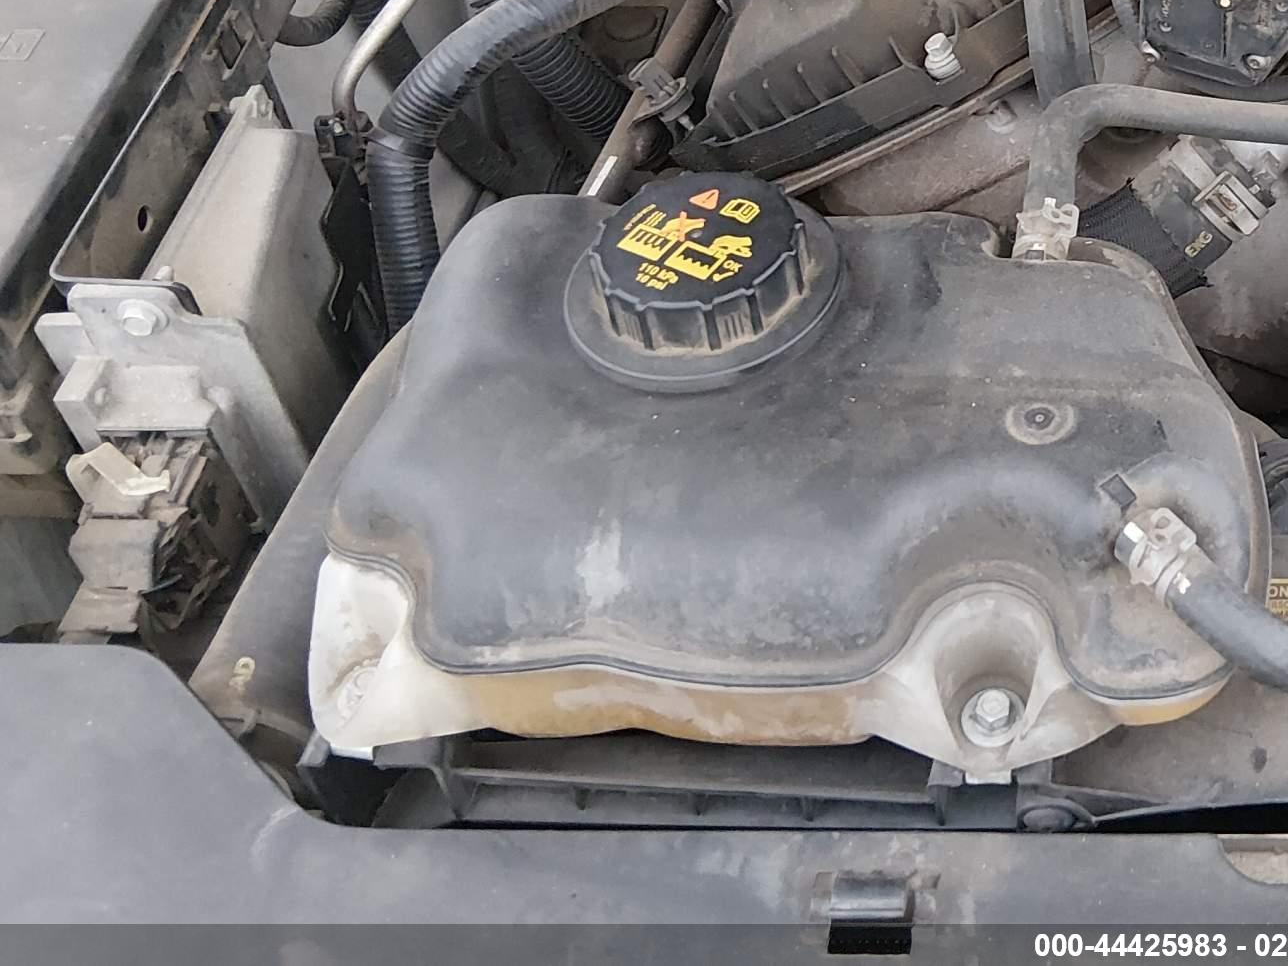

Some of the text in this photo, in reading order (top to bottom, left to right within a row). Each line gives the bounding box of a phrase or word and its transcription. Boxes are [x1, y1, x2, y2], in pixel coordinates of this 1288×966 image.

[1184, 230, 1213, 258] ENG
[638, 262, 660, 275] 110
[722, 259, 744, 273] OK
[635, 272, 669, 291] 10 psi
